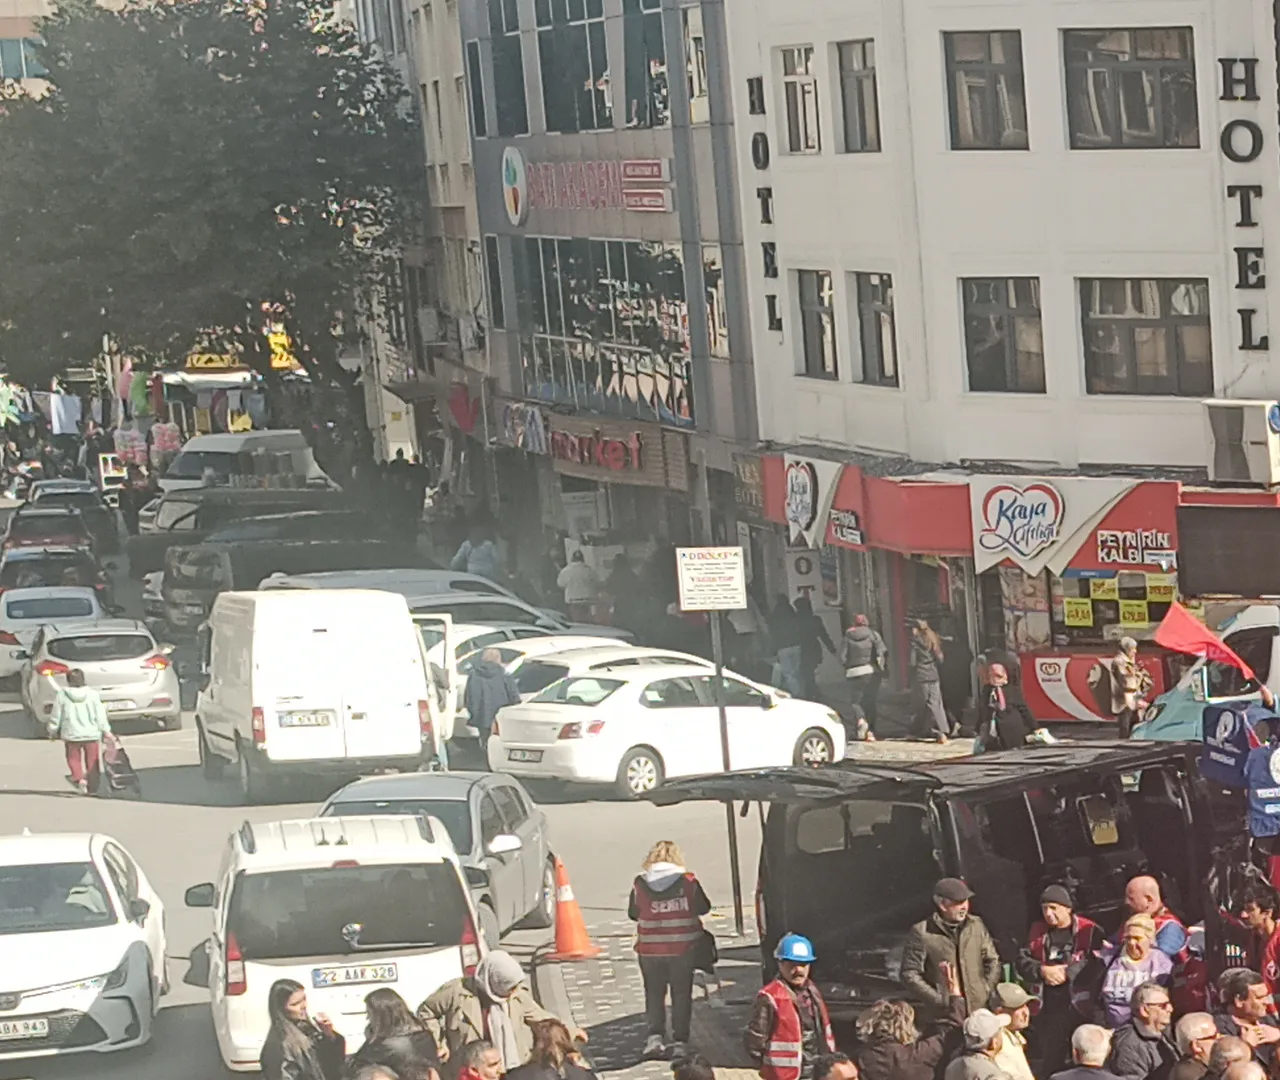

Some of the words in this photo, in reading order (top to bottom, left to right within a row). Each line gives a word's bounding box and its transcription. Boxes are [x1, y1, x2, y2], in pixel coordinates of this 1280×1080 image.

[747, 77, 783, 331] HOTEL
[1218, 58, 1269, 351] HOTEL
[999, 496, 1047, 529] Kaya
